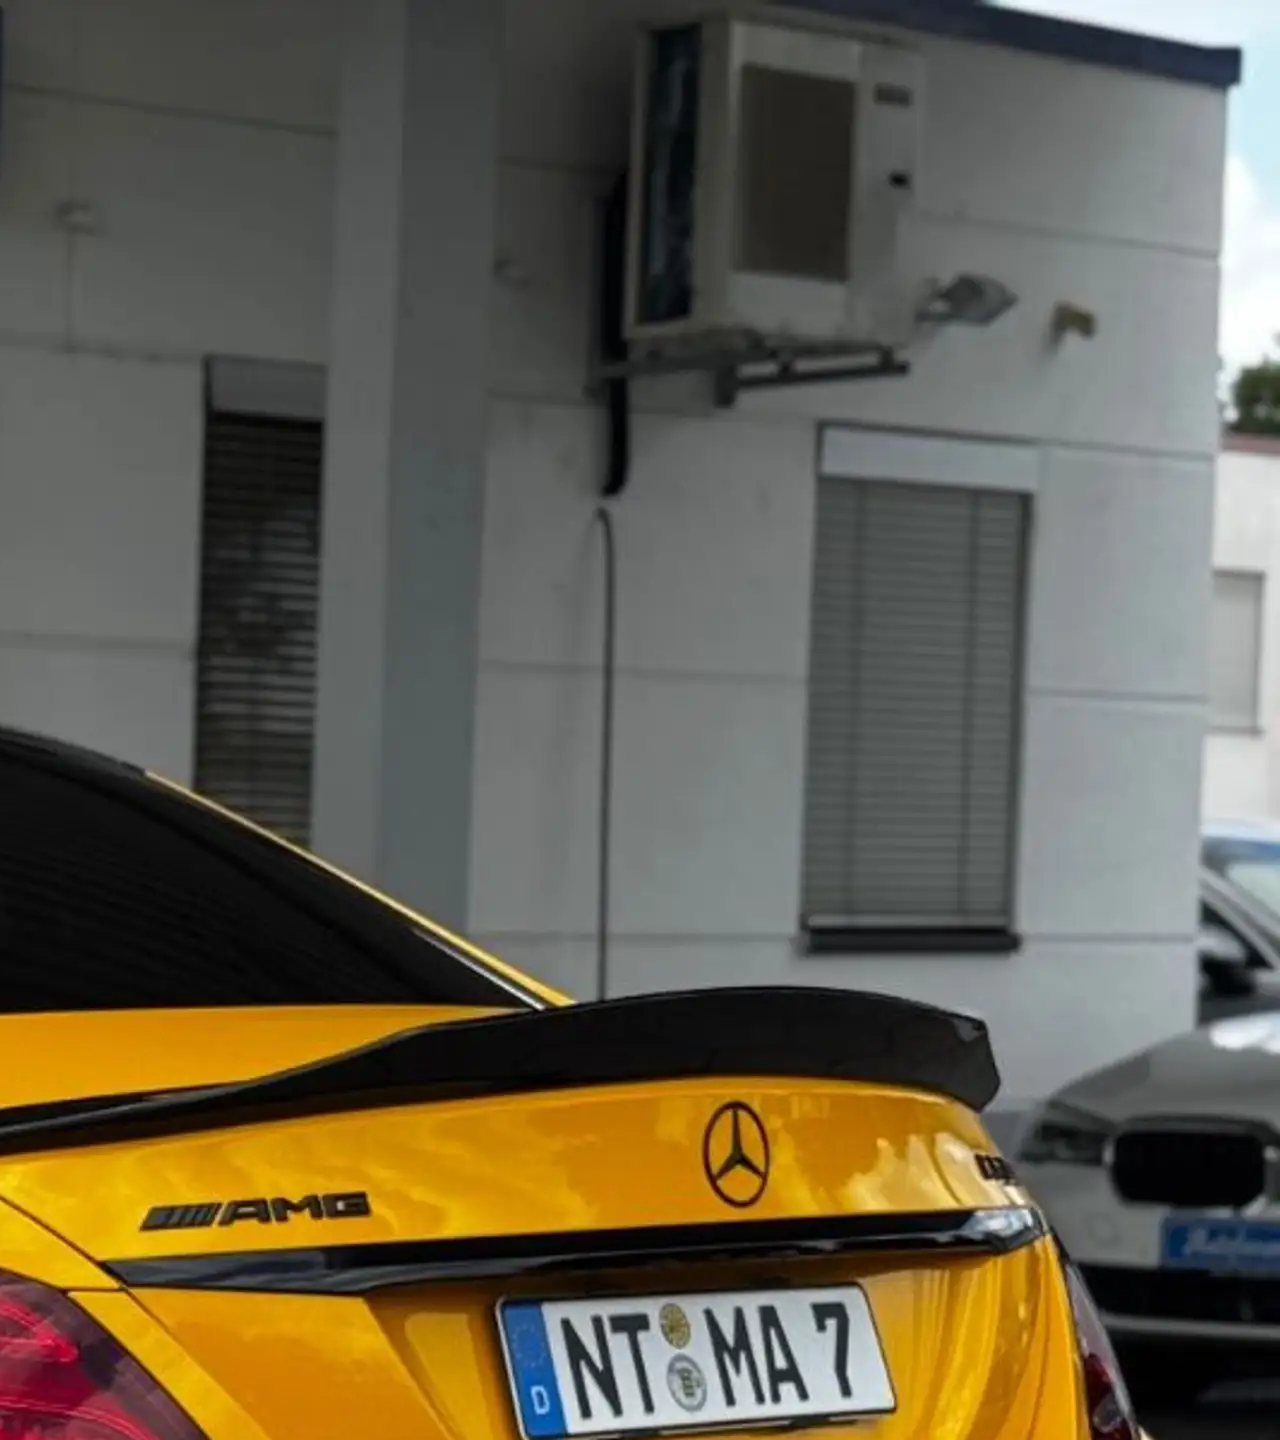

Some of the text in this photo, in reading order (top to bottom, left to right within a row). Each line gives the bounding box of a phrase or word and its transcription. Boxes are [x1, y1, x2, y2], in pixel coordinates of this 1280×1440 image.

[216, 1190, 372, 1227] AMG
[559, 1310, 656, 1421] NT
[702, 1302, 810, 1409] MA
[810, 1301, 855, 1400] 7
